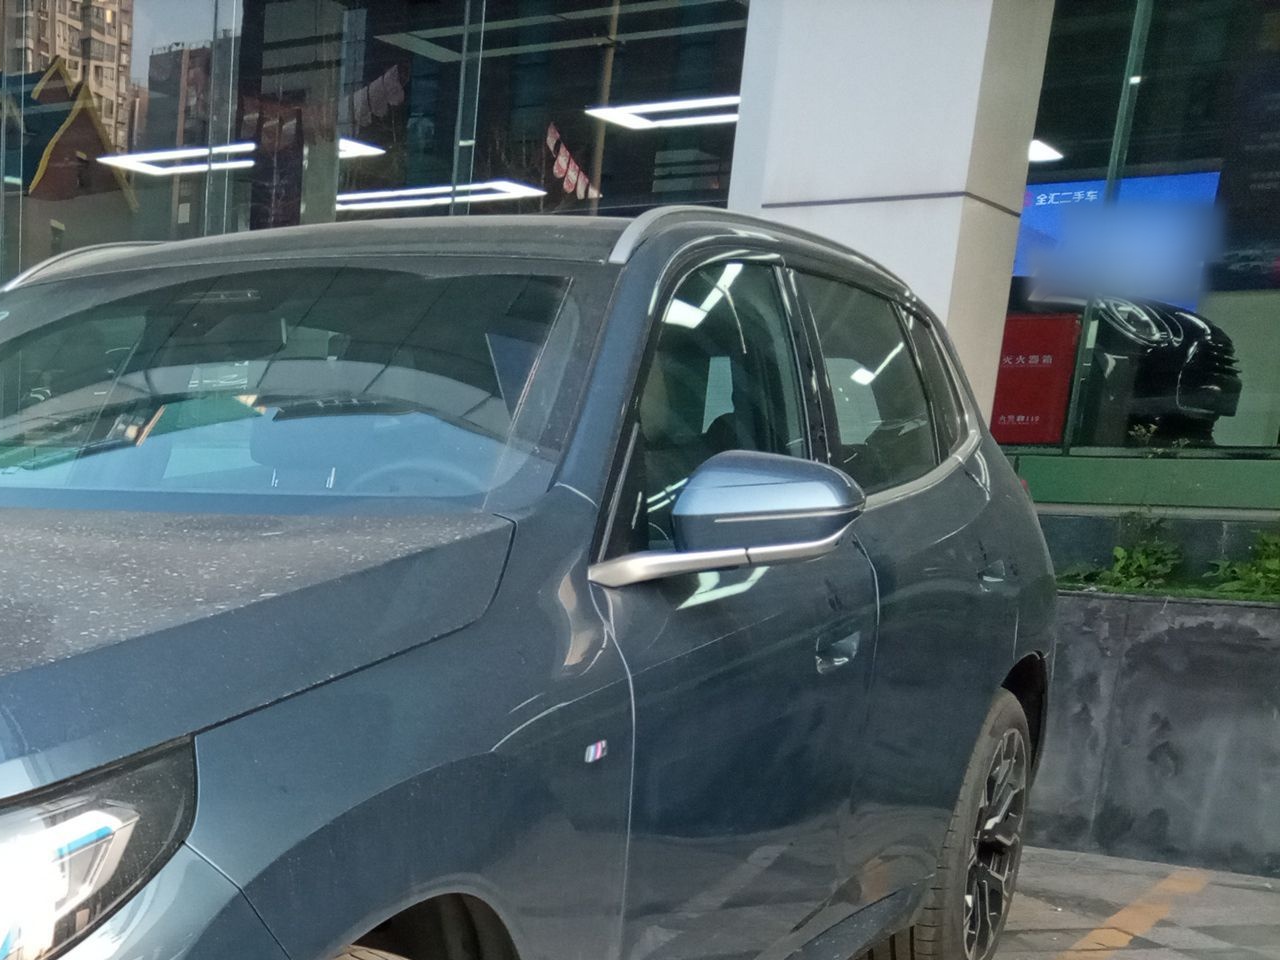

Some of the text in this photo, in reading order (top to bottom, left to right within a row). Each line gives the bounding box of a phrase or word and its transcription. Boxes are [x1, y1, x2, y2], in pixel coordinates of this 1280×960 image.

[1035, 190, 1098, 206] 全汇二手车
